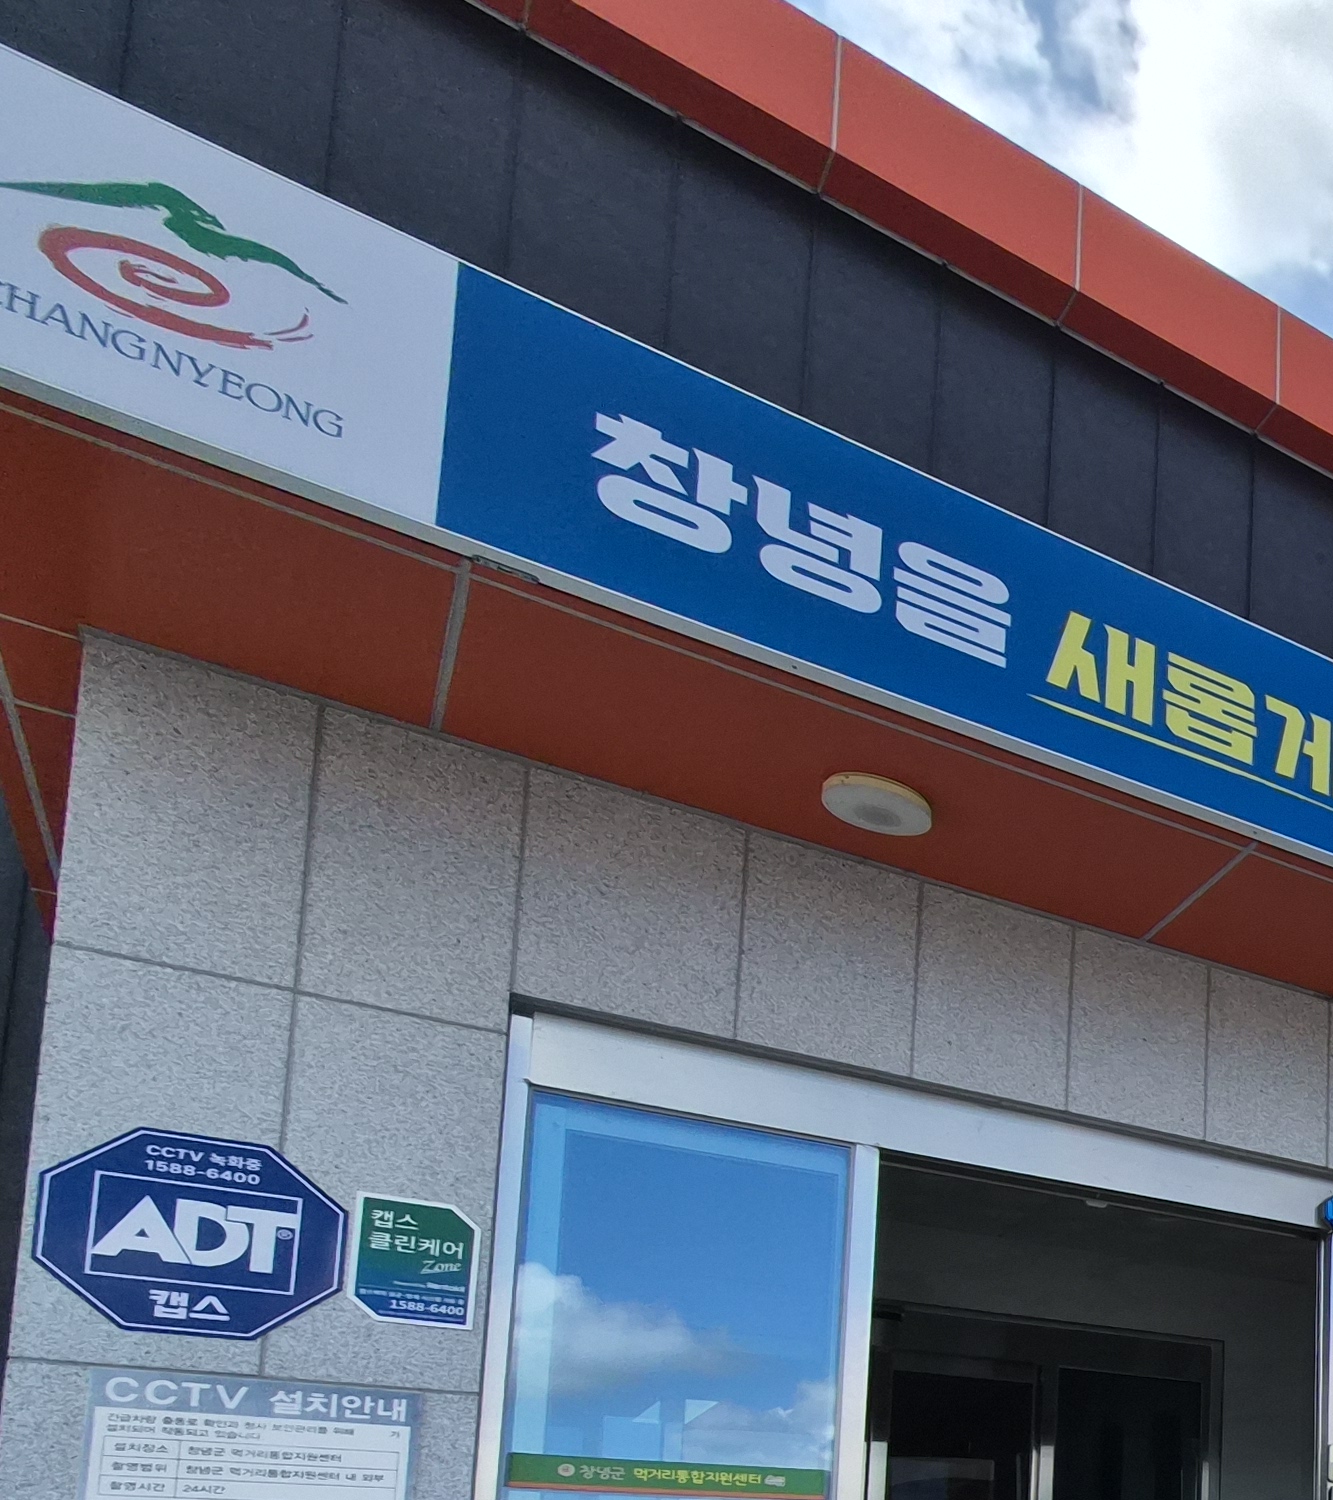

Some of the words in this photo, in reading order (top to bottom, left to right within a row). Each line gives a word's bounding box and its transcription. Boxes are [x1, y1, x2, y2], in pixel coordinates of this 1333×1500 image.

[0, 281, 344, 439] HANGNYEONG
[591, 411, 1012, 669] 창녕을
[146, 1145, 204, 1162] CCTV
[209, 1153, 263, 1171] 녹화중
[145, 1160, 260, 1185] 1588-6400
[371, 1209, 419, 1230] 캡스
[90, 1194, 301, 1274] ADT
[368, 1231, 464, 1260] 클린케어
[420, 1260, 462, 1275] Zone
[149, 1289, 230, 1322] 캡스
[389, 1299, 464, 1316] 1588-6400
[105, 1376, 249, 1410] CCTV
[269, 1390, 407, 1422] 설치안내
[579, 1465, 625, 1480] 창녕군
[633, 1467, 762, 1486] 먹거리통합지원센터
[182, 1484, 226, 1495] 24시간
